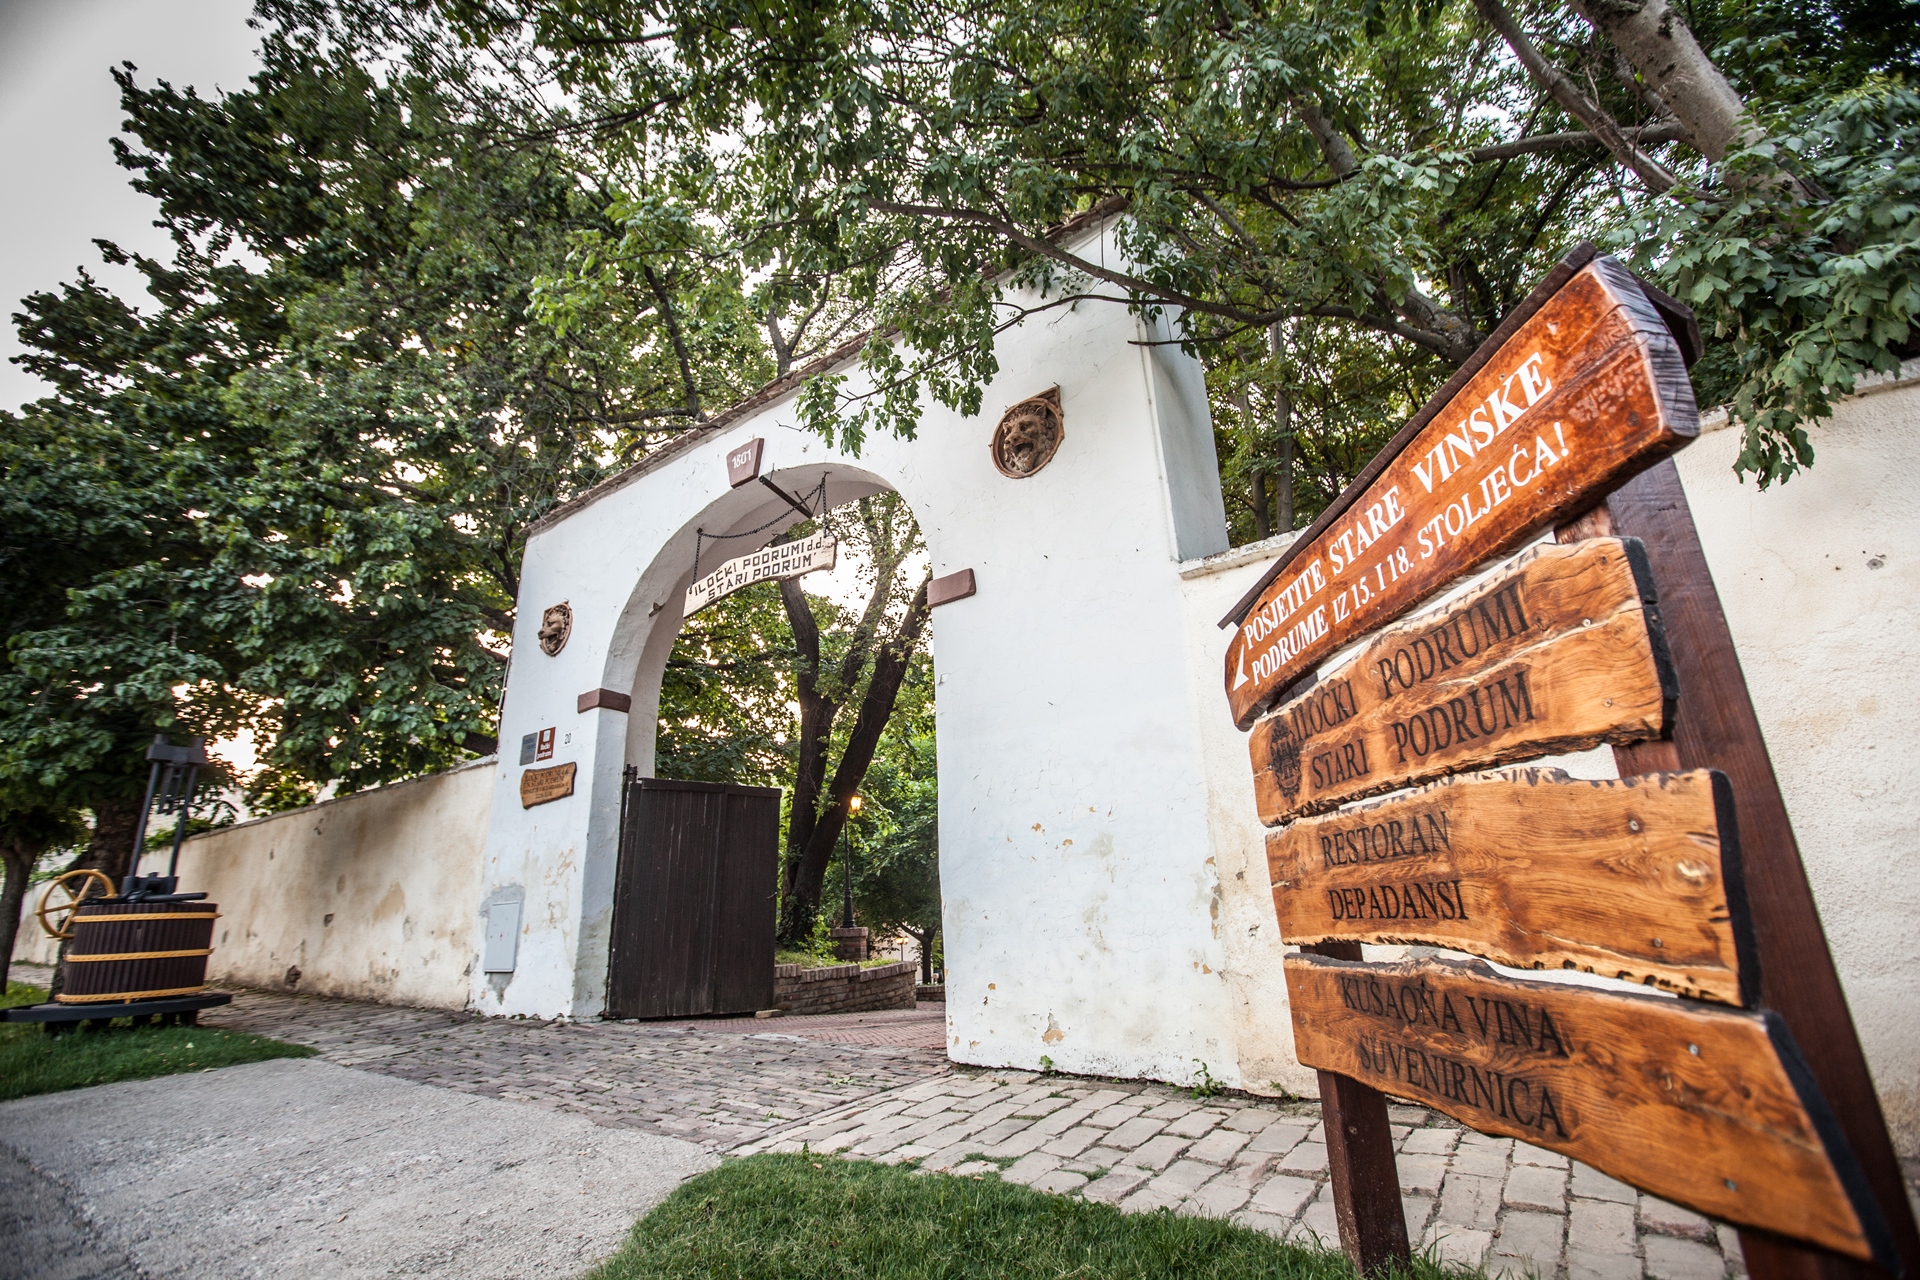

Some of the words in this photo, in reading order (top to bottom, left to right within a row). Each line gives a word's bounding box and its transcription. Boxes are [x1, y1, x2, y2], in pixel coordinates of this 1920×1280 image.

[1244, 558, 1327, 651] POSJETITE
[1328, 485, 1406, 576] STARE
[1410, 352, 1553, 494] VINSKE
[742, 542, 805, 570] PODRUMI
[1251, 604, 1329, 687] PODRUME
[1332, 591, 1351, 625] IZ
[1351, 576, 1375, 610] 15.
[1375, 563, 1386, 591] I
[1387, 546, 1414, 583] 18.
[1417, 422, 1569, 560] STOLJEĆA!
[1377, 577, 1531, 700] PODRUMI
[564, 733, 572, 744] 20
[1311, 738, 1370, 790] STARI
[1391, 670, 1535, 764] PODRUM
[1320, 811, 1452, 868] RESTORAN
[1327, 879, 1469, 920] DEPADANSI
[1341, 975, 1465, 1035] KUŠAONA
[1465, 995, 1571, 1059] VINA
[1358, 1034, 1570, 1139] SUVENIRNICA
